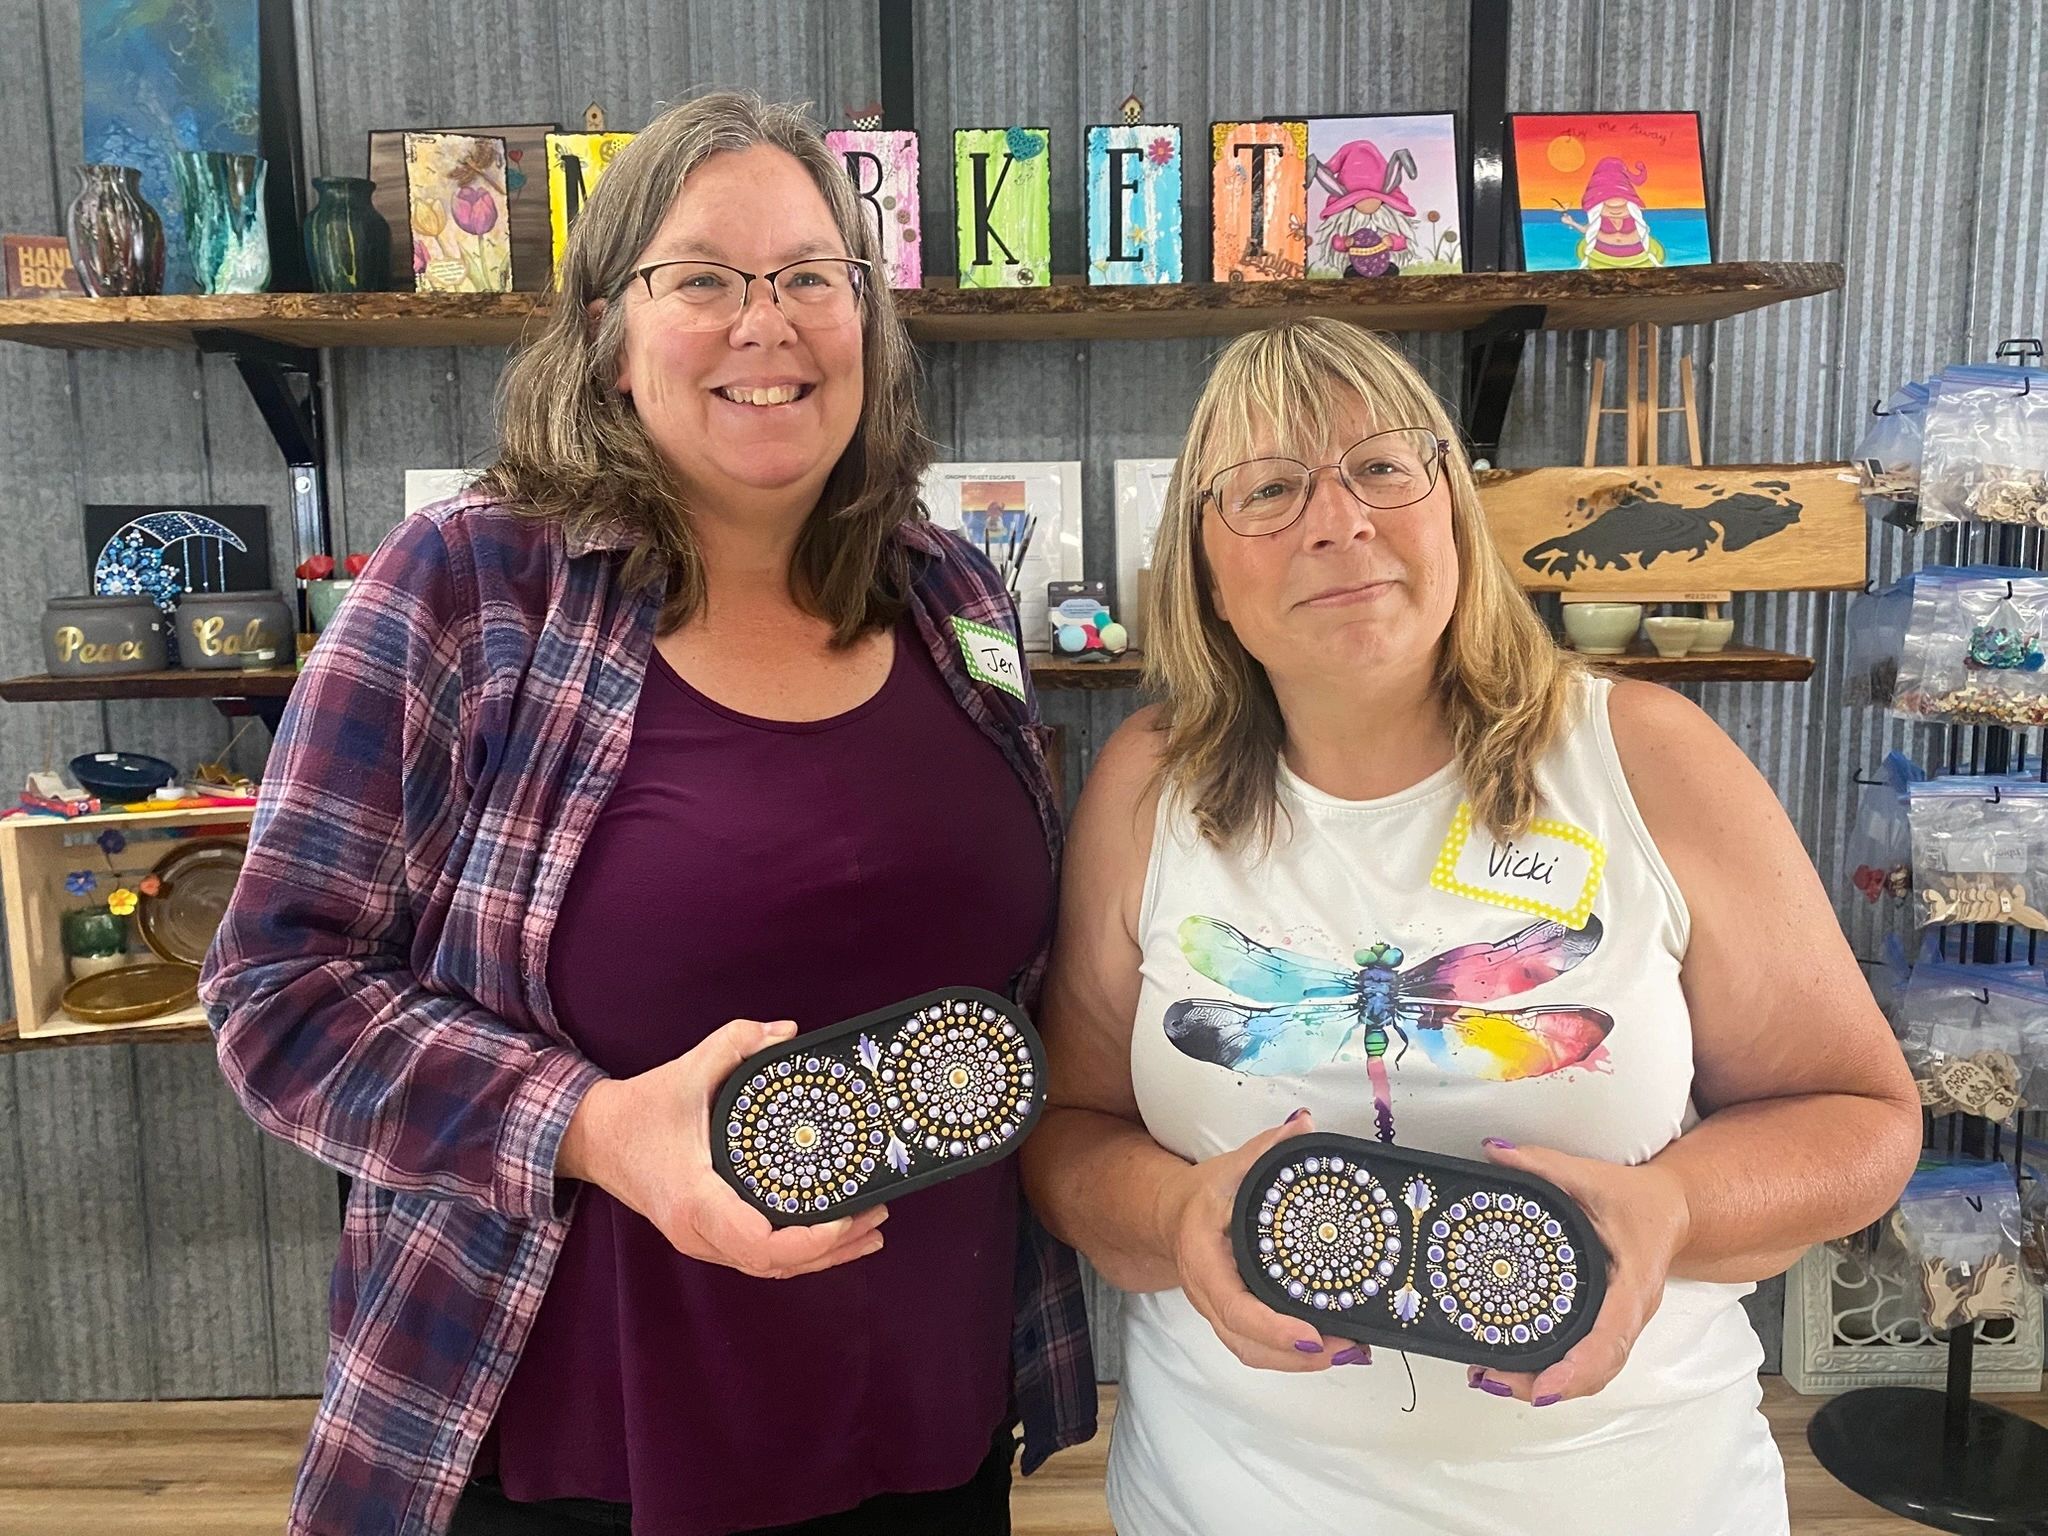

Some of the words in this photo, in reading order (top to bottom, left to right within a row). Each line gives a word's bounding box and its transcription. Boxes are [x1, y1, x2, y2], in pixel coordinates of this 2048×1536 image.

[20, 267, 67, 288] BOX
[981, 648, 1018, 679] Jen
[1488, 841, 1559, 885] Vicki
